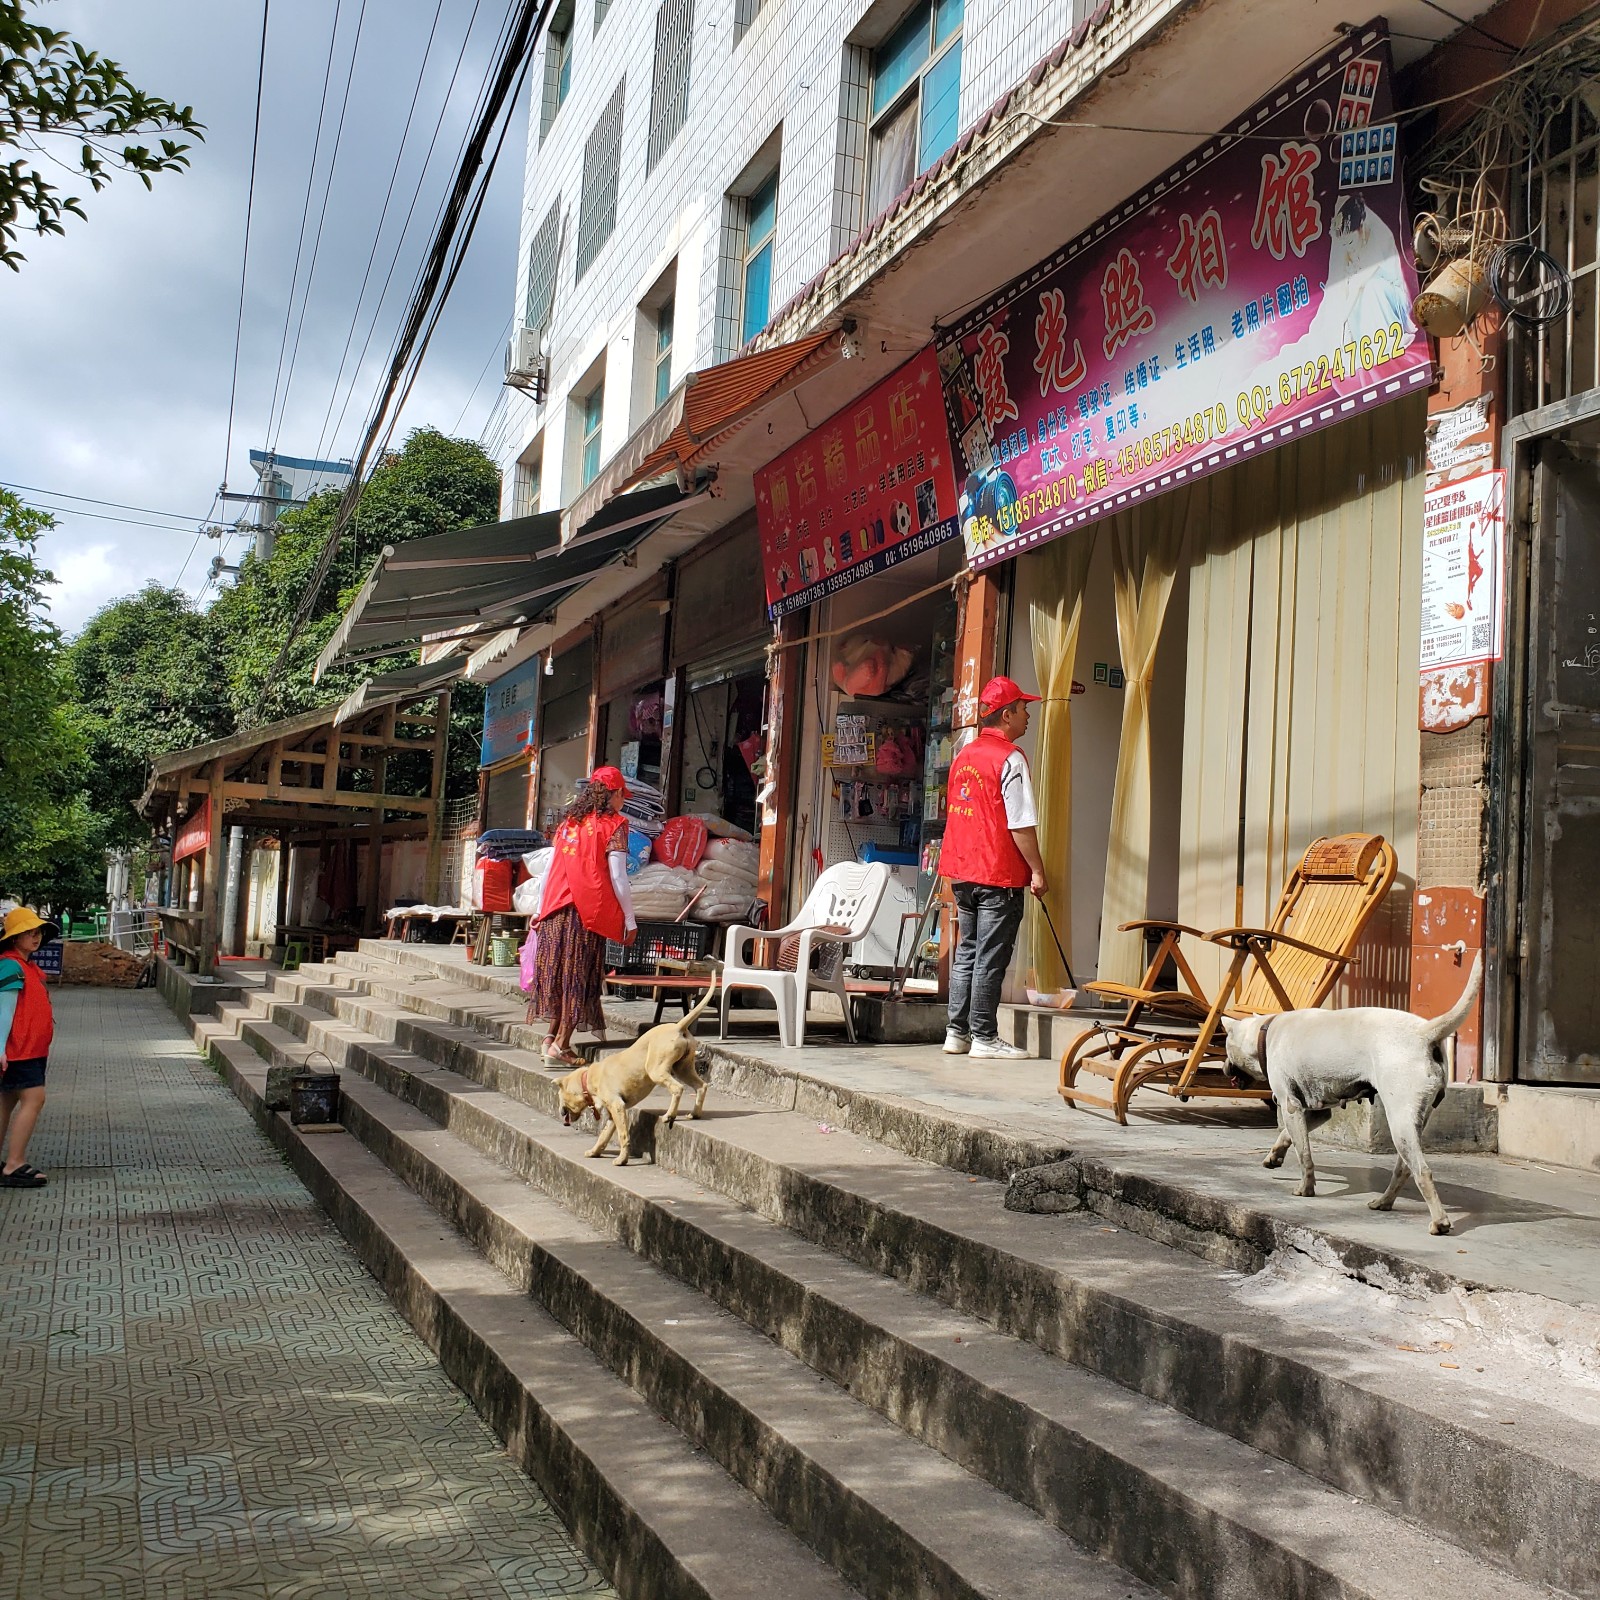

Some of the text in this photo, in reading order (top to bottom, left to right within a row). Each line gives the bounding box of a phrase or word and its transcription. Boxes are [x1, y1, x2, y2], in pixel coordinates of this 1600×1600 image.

[973, 142, 1322, 434] 霞光照相馆
[877, 451, 927, 494] 学生用品等
[996, 473, 1077, 533] 15185734870
[1117, 402, 1227, 478] 15185734870
[1278, 321, 1406, 407] 672247622
[827, 560, 874, 592] 13595574989
[899, 522, 953, 559] 1519640965
